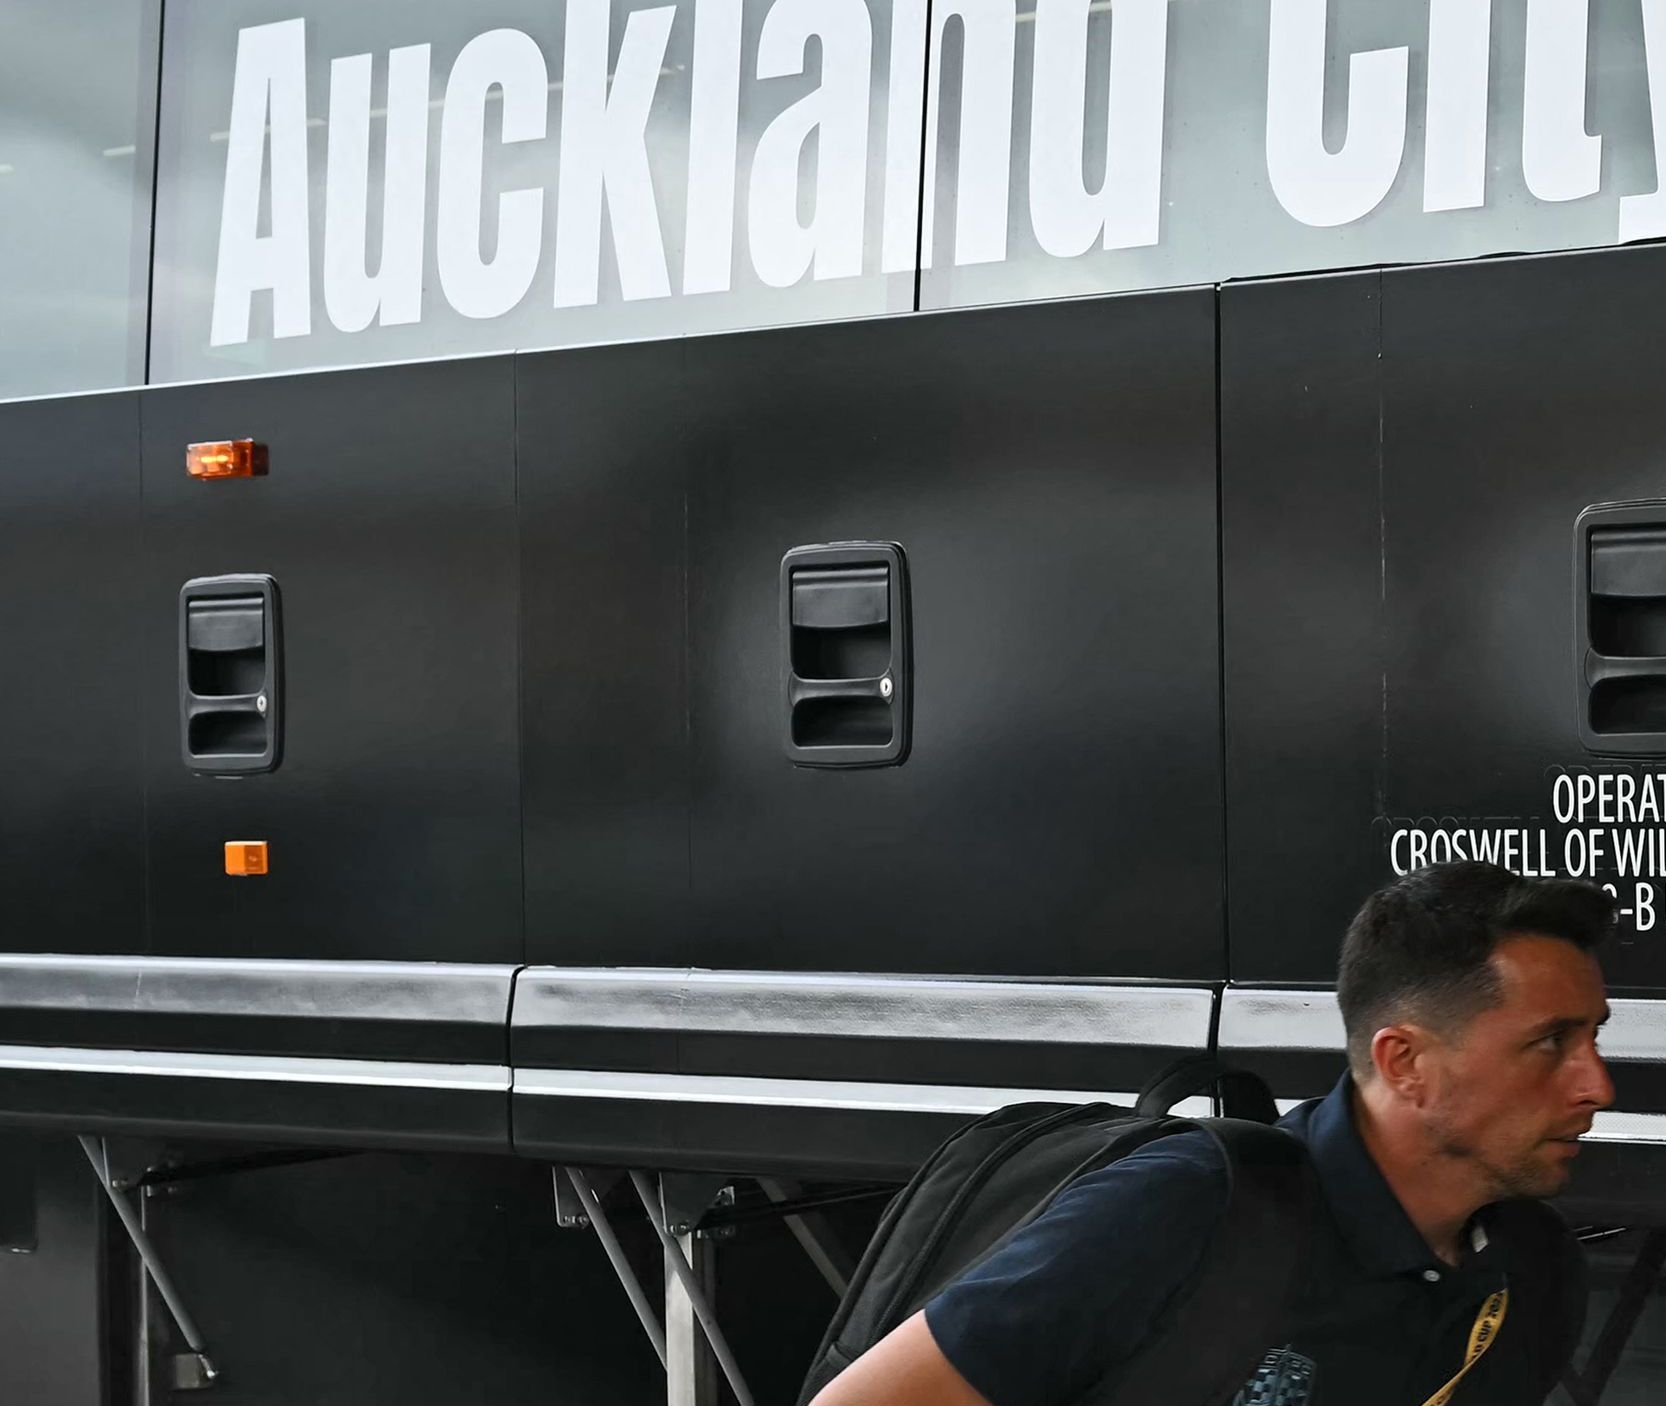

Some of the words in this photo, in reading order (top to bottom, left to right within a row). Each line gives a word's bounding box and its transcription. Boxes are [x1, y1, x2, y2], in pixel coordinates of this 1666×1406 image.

[210, 0, 1167, 346] Auckland
[1390, 828, 1556, 877] CROSWELL
[1564, 828, 1605, 877] OF
